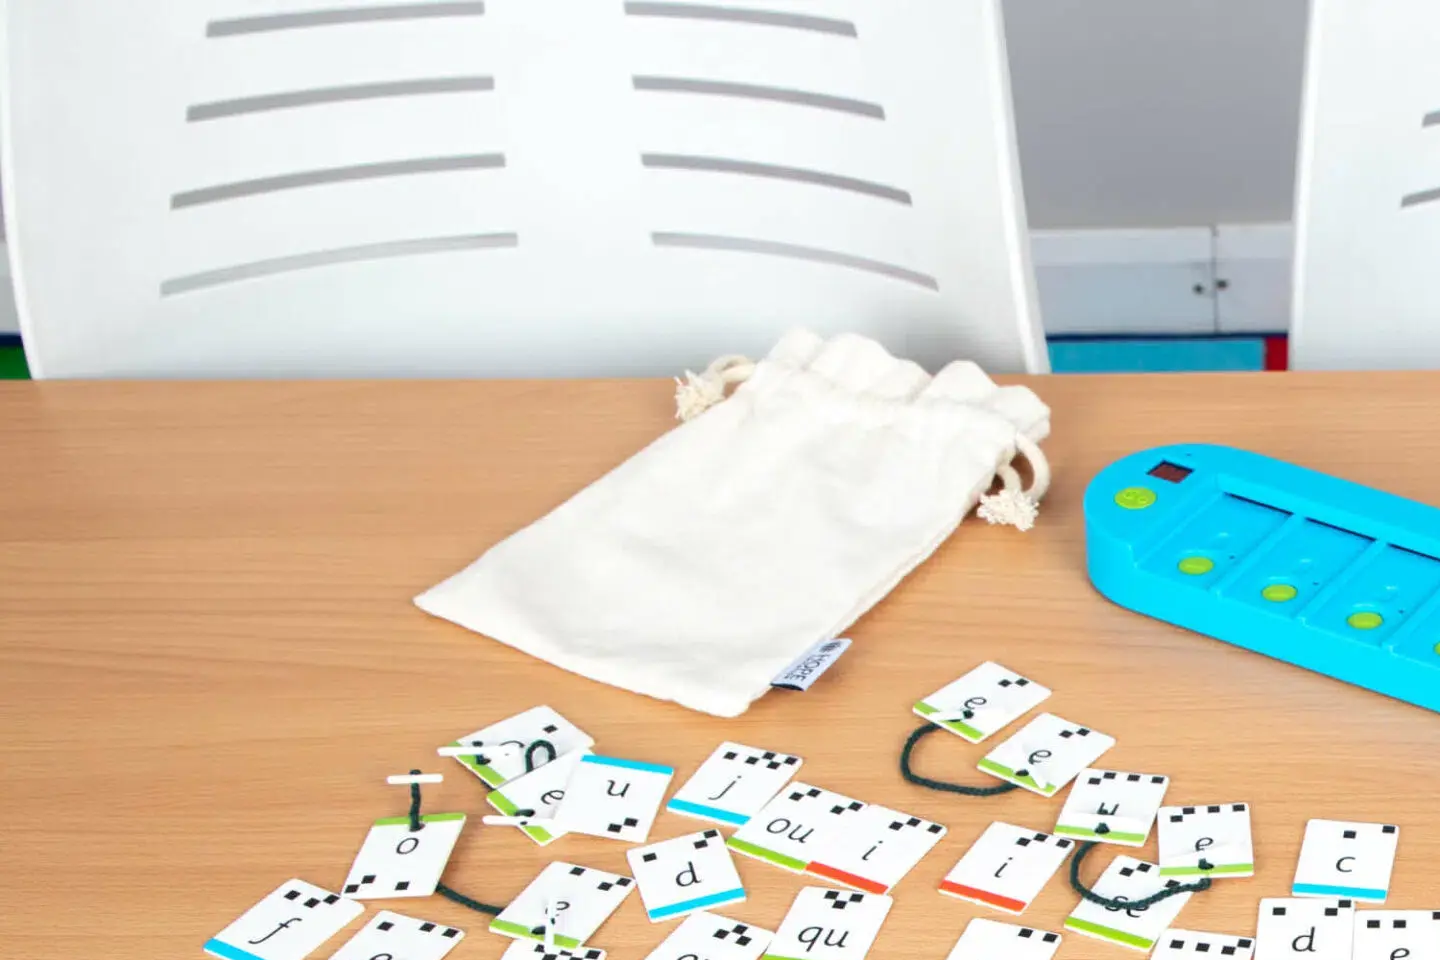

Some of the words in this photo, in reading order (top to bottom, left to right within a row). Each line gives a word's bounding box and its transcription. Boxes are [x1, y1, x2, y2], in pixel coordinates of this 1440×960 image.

[1028, 750, 1052, 765] e
[540, 789, 565, 805] e
[706, 774, 742, 801] j
[766, 818, 814, 844] ou
[396, 837, 419, 855] o
[862, 840, 883, 861] i
[675, 861, 701, 887] d
[994, 857, 1013, 878] i
[1335, 856, 1356, 873] c
[248, 917, 302, 945] f
[797, 926, 849, 952] qu
[1291, 926, 1316, 952] d
